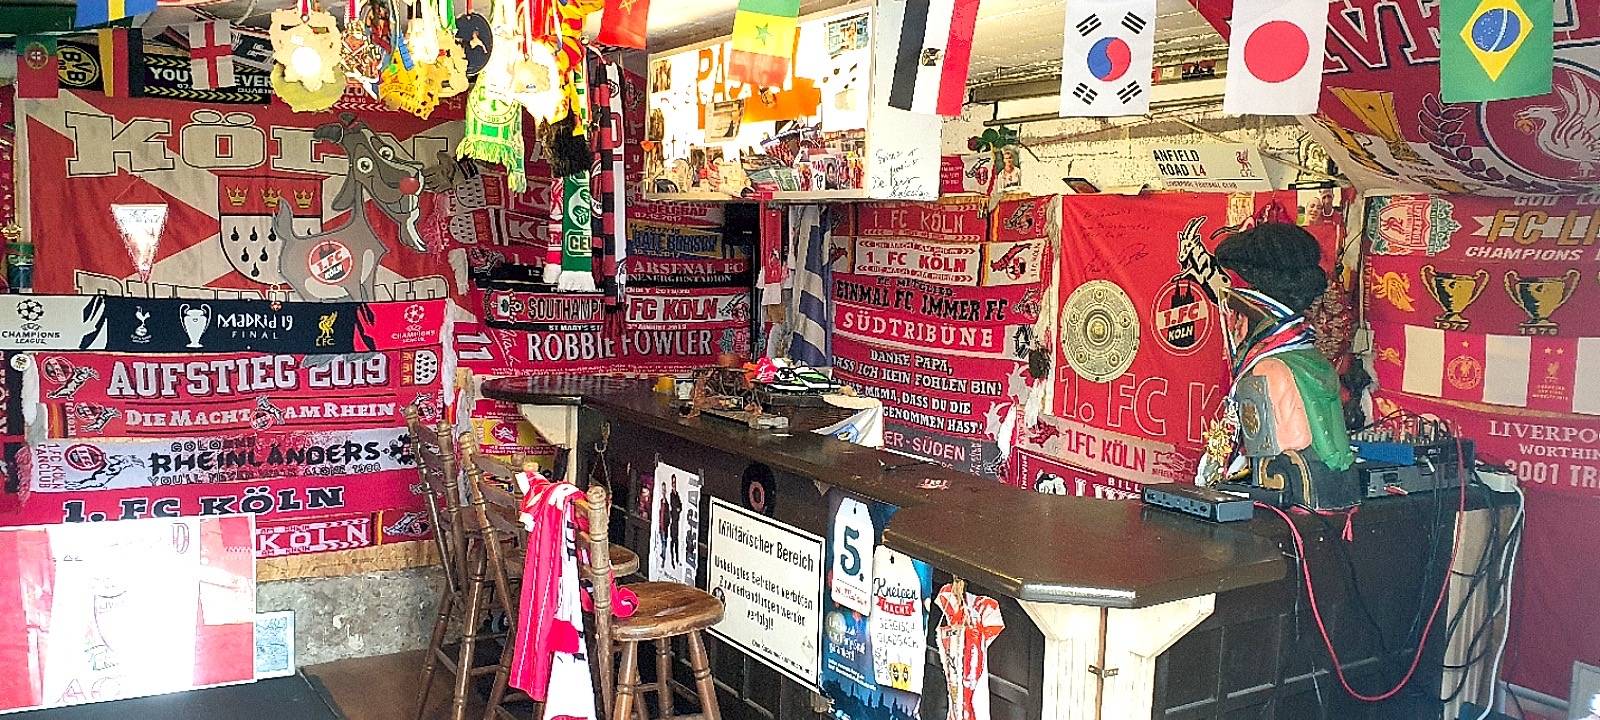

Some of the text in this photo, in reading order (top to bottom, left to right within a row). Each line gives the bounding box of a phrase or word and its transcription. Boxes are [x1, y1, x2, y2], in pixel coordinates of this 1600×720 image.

[235, 74, 272, 88] EVER
[1153, 149, 1200, 162] ANFIELD
[1158, 163, 1207, 177] ROAD L4
[891, 209, 907, 228] FC
[920, 210, 964, 234] KÖLN
[1486, 209, 1600, 246] FC LI
[887, 251, 908, 267] FC
[918, 251, 967, 273] KÖLN
[1465, 246, 1584, 261] CHAMPIONS
[634, 260, 744, 274] ARSENAL FC
[527, 296, 604, 321] SOUTHAMPT
[630, 297, 658, 321] FC
[836, 279, 890, 308] EINMAL
[921, 293, 980, 322] IMMER
[985, 299, 1008, 321] FC
[281, 314, 294, 331] 19
[1163, 303, 1199, 327] 1.FC
[2, 330, 60, 338] CHAMPIONS
[231, 331, 278, 340] FINAL
[391, 330, 435, 340] CHAMPIONS
[843, 310, 993, 349] SÜDTRIBÜNE
[1168, 325, 1196, 342] KÖLN
[316, 338, 335, 347] LFC
[527, 332, 617, 361] ROBBIE
[621, 329, 712, 357] FOWLER
[871, 349, 953, 374] DANKE PAPA,
[106, 352, 388, 398] AUFSTIEG 2019
[857, 363, 878, 379] ICH
[882, 368, 911, 385] KEIN
[915, 374, 966, 393] FOHLEN
[971, 381, 1002, 396] BIN!
[865, 385, 900, 405] MAMA,
[902, 391, 928, 409] DASS
[932, 397, 947, 411] DU
[950, 401, 971, 415] DIE
[1106, 372, 1168, 436] FC
[126, 402, 395, 426] DIE MACHT AM RHEIN
[947, 418, 983, 435] HAST!
[1489, 420, 1600, 444] LIVERPO
[1101, 439, 1146, 473] KÖLN
[1107, 477, 1143, 494] BILL
[1569, 464, 1600, 488] TR
[64, 486, 346, 524] 1. FC KÖLN
[259, 521, 367, 551] KÖLN
[718, 518, 814, 573] Militärischer Bereich
[840, 525, 865, 583] 5.
